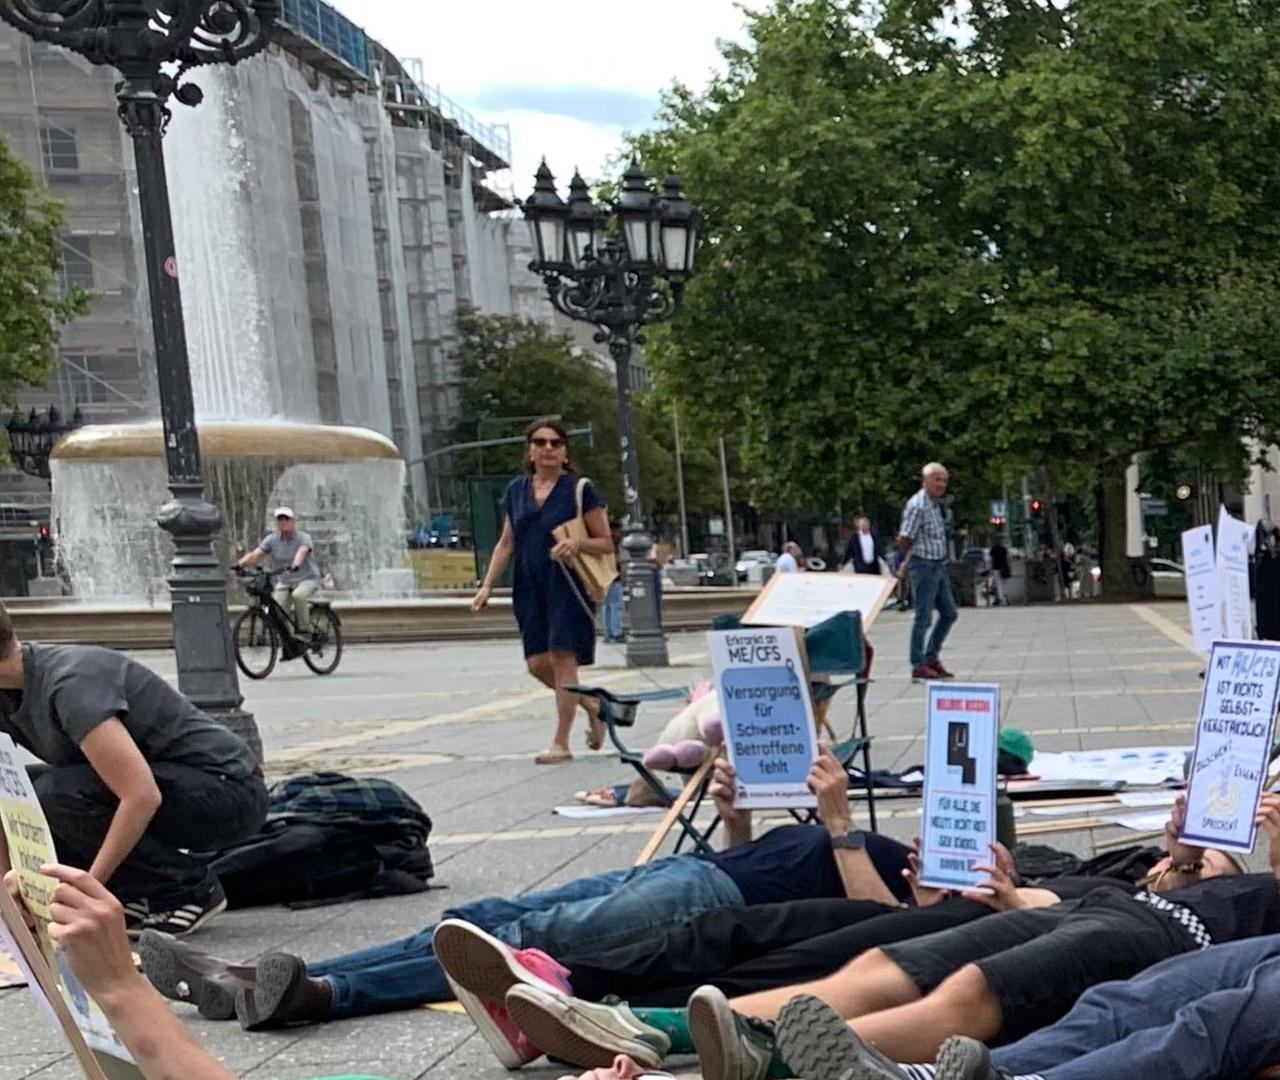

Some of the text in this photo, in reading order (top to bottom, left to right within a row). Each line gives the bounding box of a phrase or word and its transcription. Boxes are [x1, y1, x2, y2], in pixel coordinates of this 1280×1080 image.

[725, 634, 777, 645] Erkrankt an
[729, 647, 782, 664] ME/CFS
[725, 685, 800, 701] Versorgung
[1217, 681, 1264, 698] IST NICHTS
[754, 704, 773, 717] für
[1220, 699, 1260, 716] SELBST-
[737, 723, 800, 737] Schwerst-
[736, 741, 805, 756] Betroffene
[759, 760, 789, 775] fehlt
